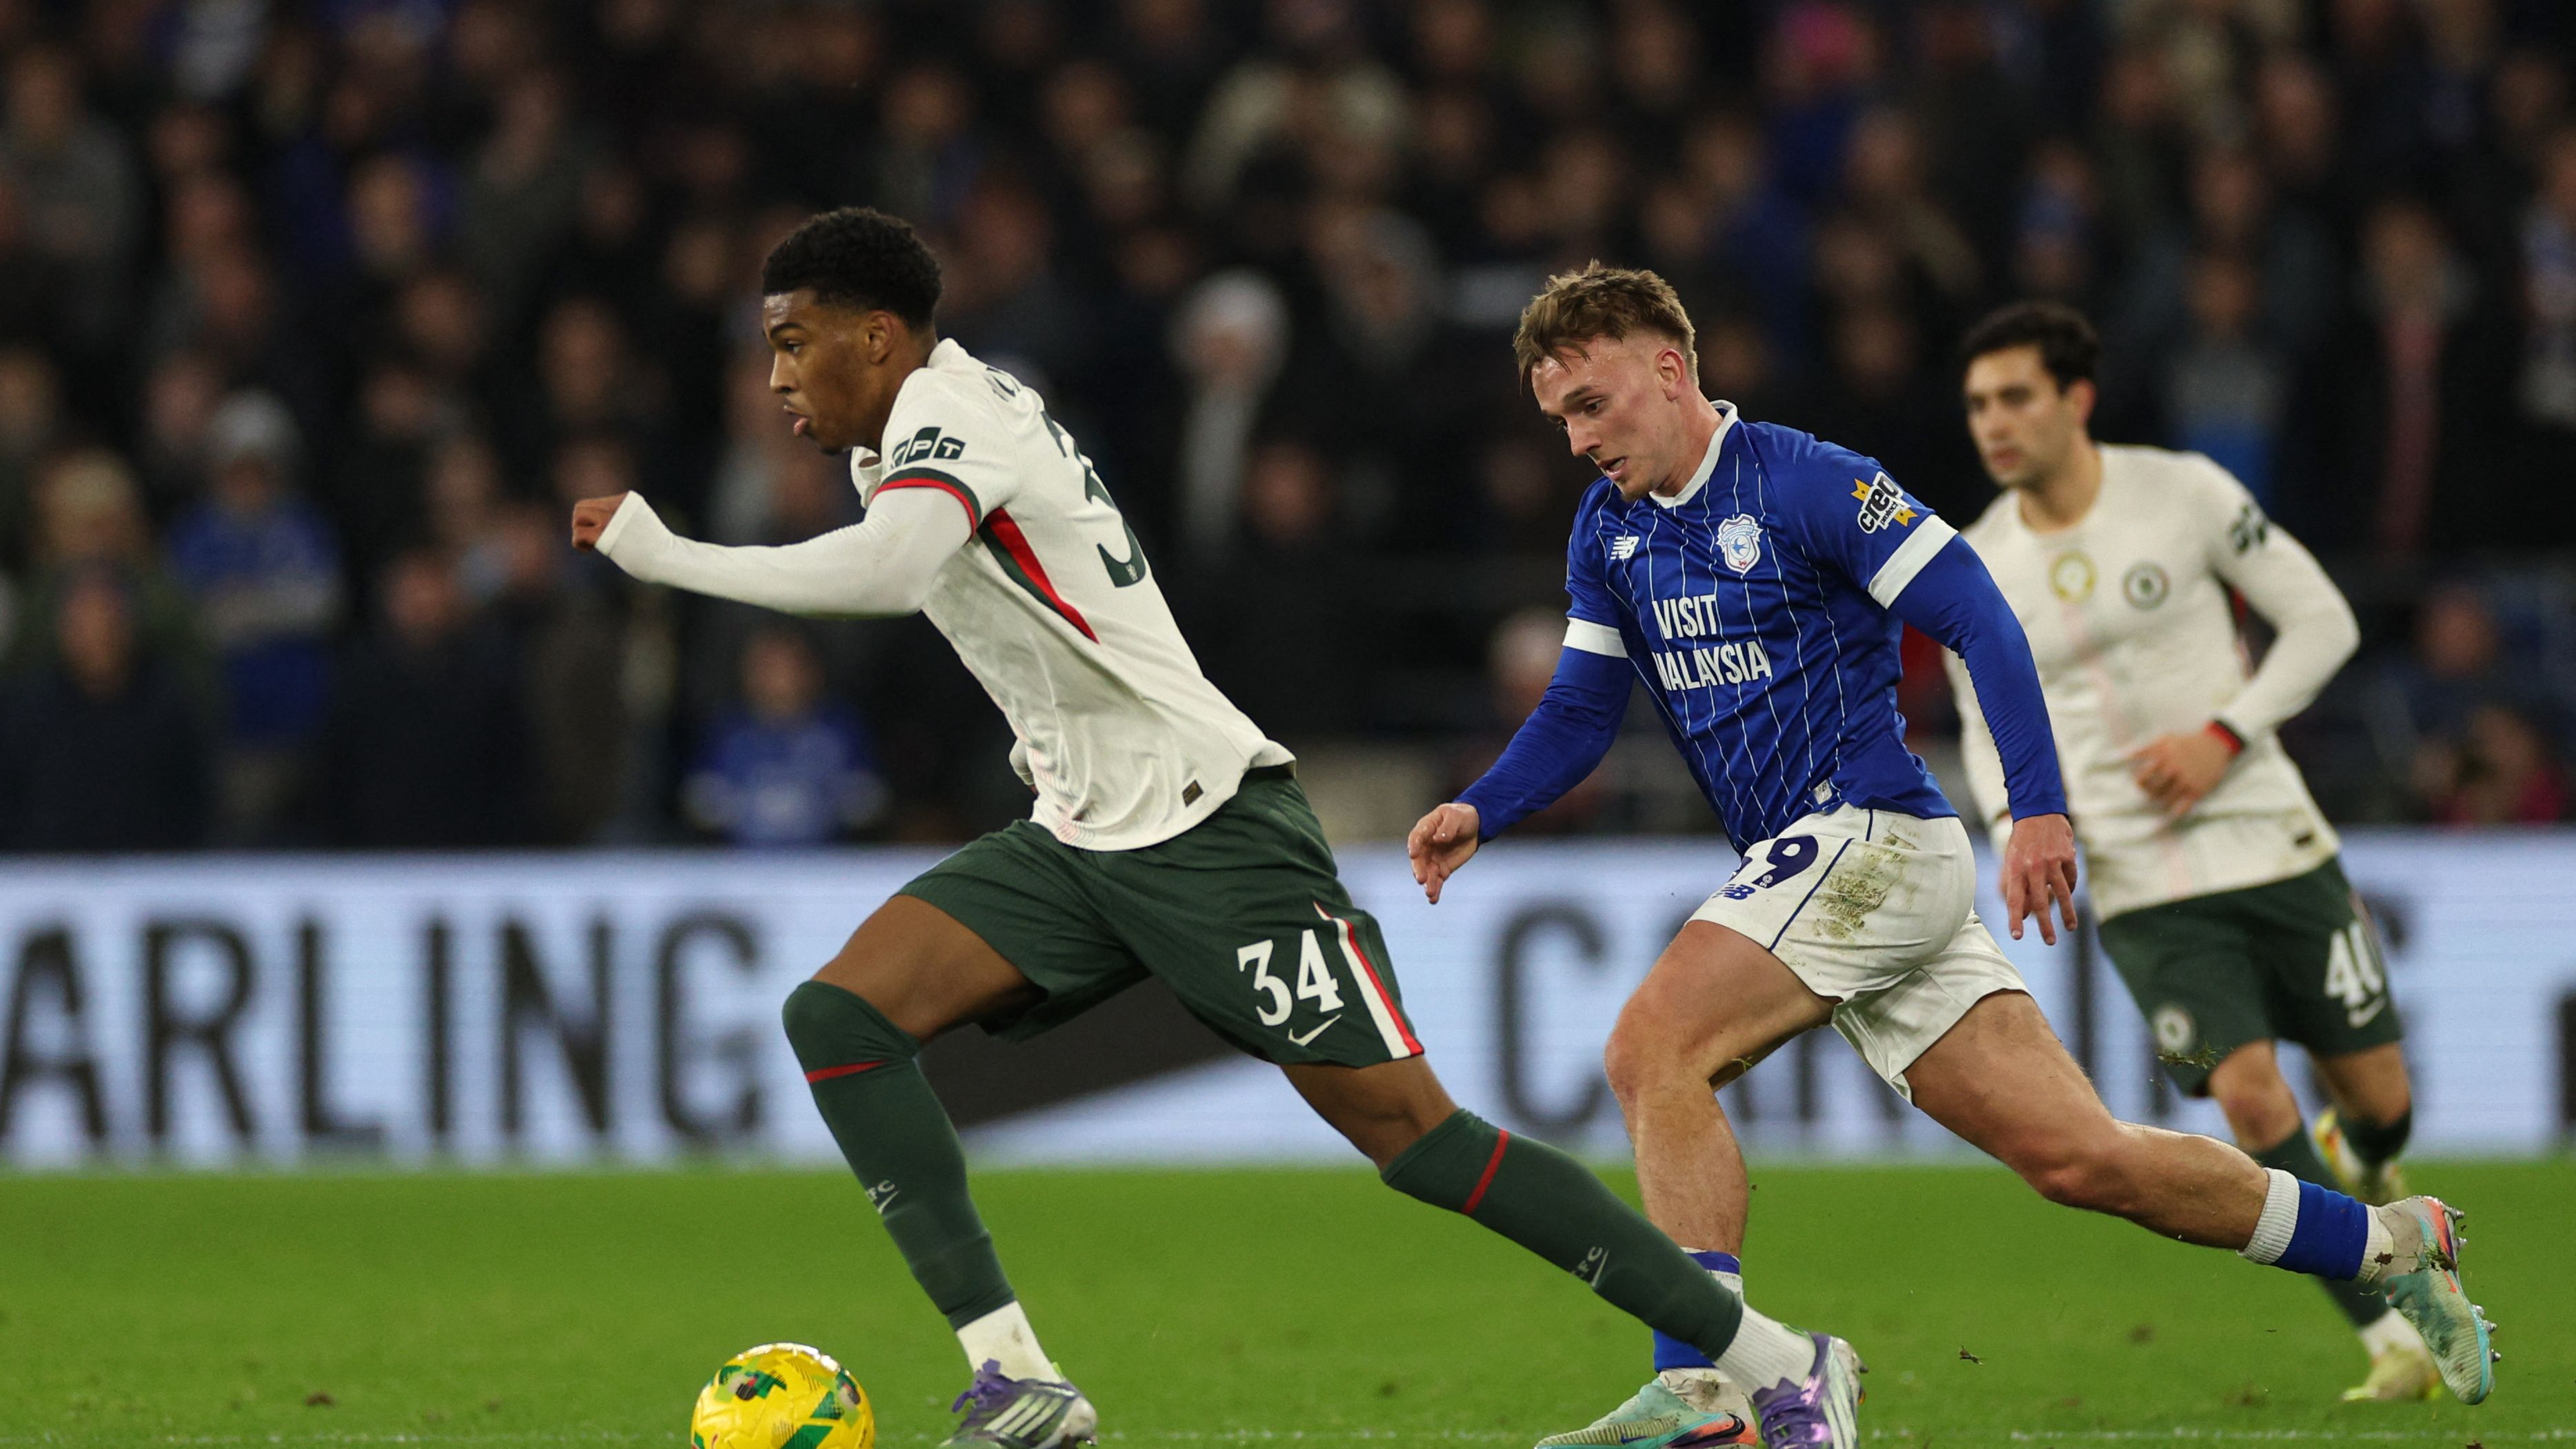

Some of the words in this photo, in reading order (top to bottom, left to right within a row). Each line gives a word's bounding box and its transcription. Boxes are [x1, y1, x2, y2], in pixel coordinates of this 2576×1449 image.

[1652, 594, 1717, 639] VISIT
[1652, 641, 1772, 690] MALAYSIA
[1237, 929, 1344, 1026] 34
[0, 905, 768, 1139] ARLING
